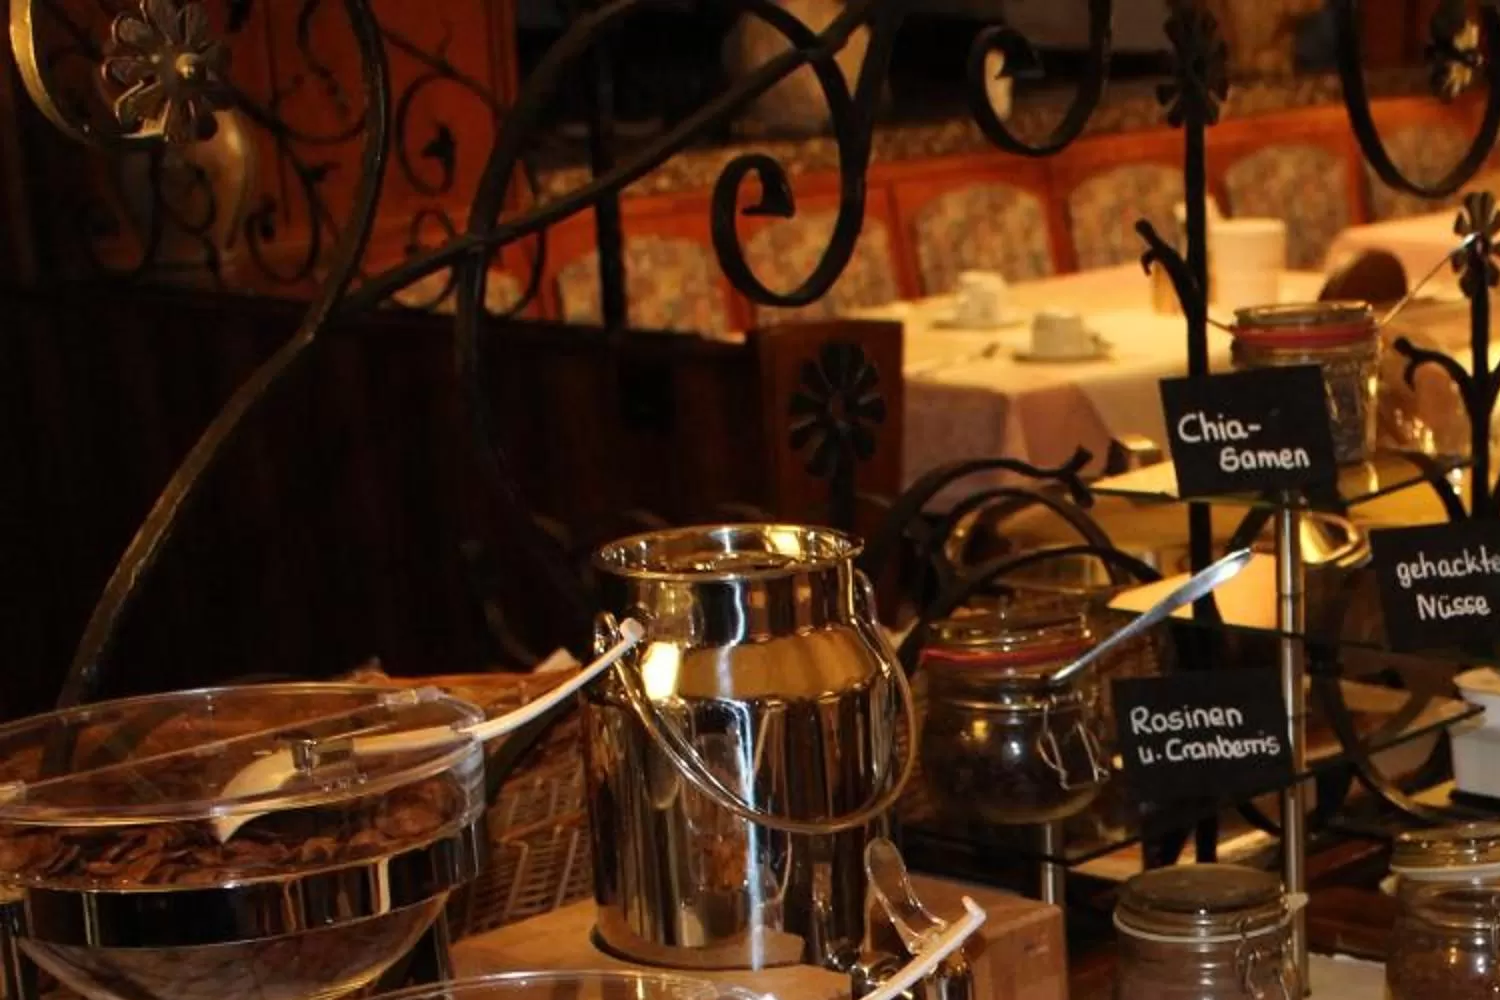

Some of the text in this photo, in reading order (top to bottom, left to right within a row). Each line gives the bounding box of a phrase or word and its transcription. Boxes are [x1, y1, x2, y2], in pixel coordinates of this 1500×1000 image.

[1177, 411, 1262, 443] Chia-
[1219, 446, 1311, 472] Samen
[1416, 594, 1491, 621] Nüsse
[1130, 705, 1243, 735] Rosinen
